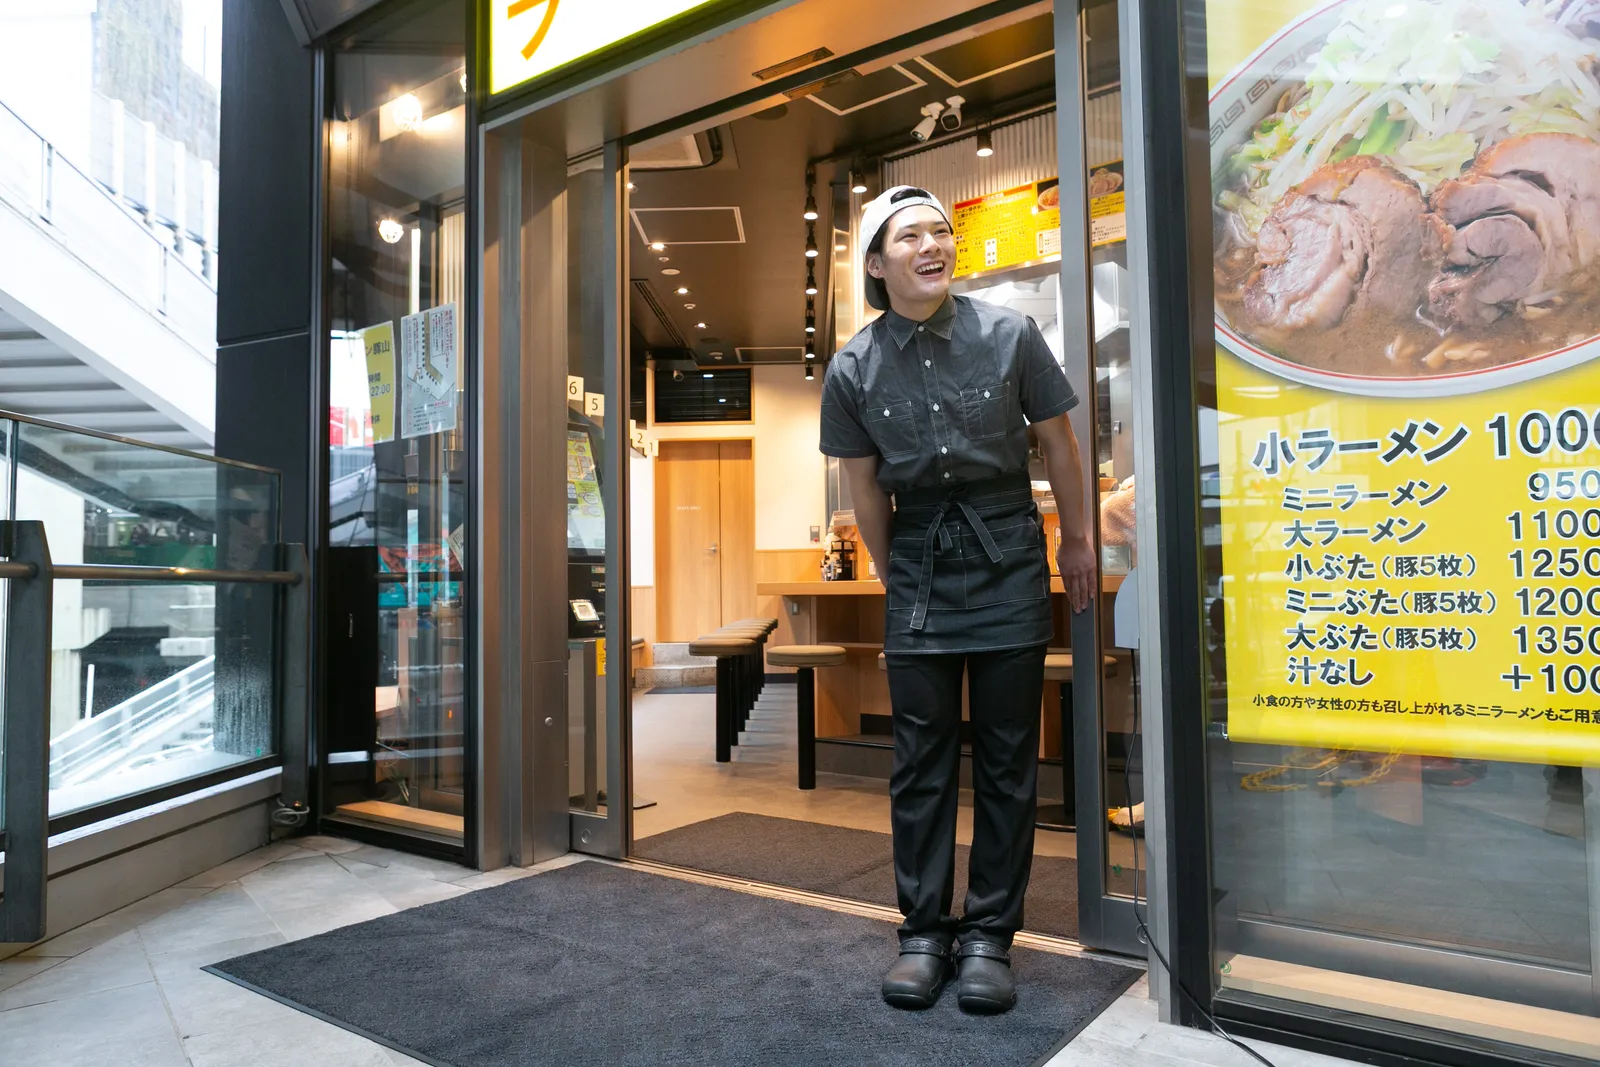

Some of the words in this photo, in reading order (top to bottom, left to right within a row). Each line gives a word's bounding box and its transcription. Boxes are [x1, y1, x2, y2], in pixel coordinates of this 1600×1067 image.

[569, 381, 577, 395] 6
[591, 398, 598, 411] 5
[637, 432, 643, 444] 2
[1253, 421, 1468, 475] 小ラーメン
[1488, 410, 1600, 457] 100
[1283, 481, 1448, 511] ミニラーメン
[1529, 471, 1600, 501] 950
[1283, 518, 1427, 547] 大ラーメン
[1508, 510, 1600, 540] 1100
[1510, 549, 1600, 578] 1250
[1516, 586, 1600, 616] 1200
[1287, 657, 1375, 686] 汁なし
